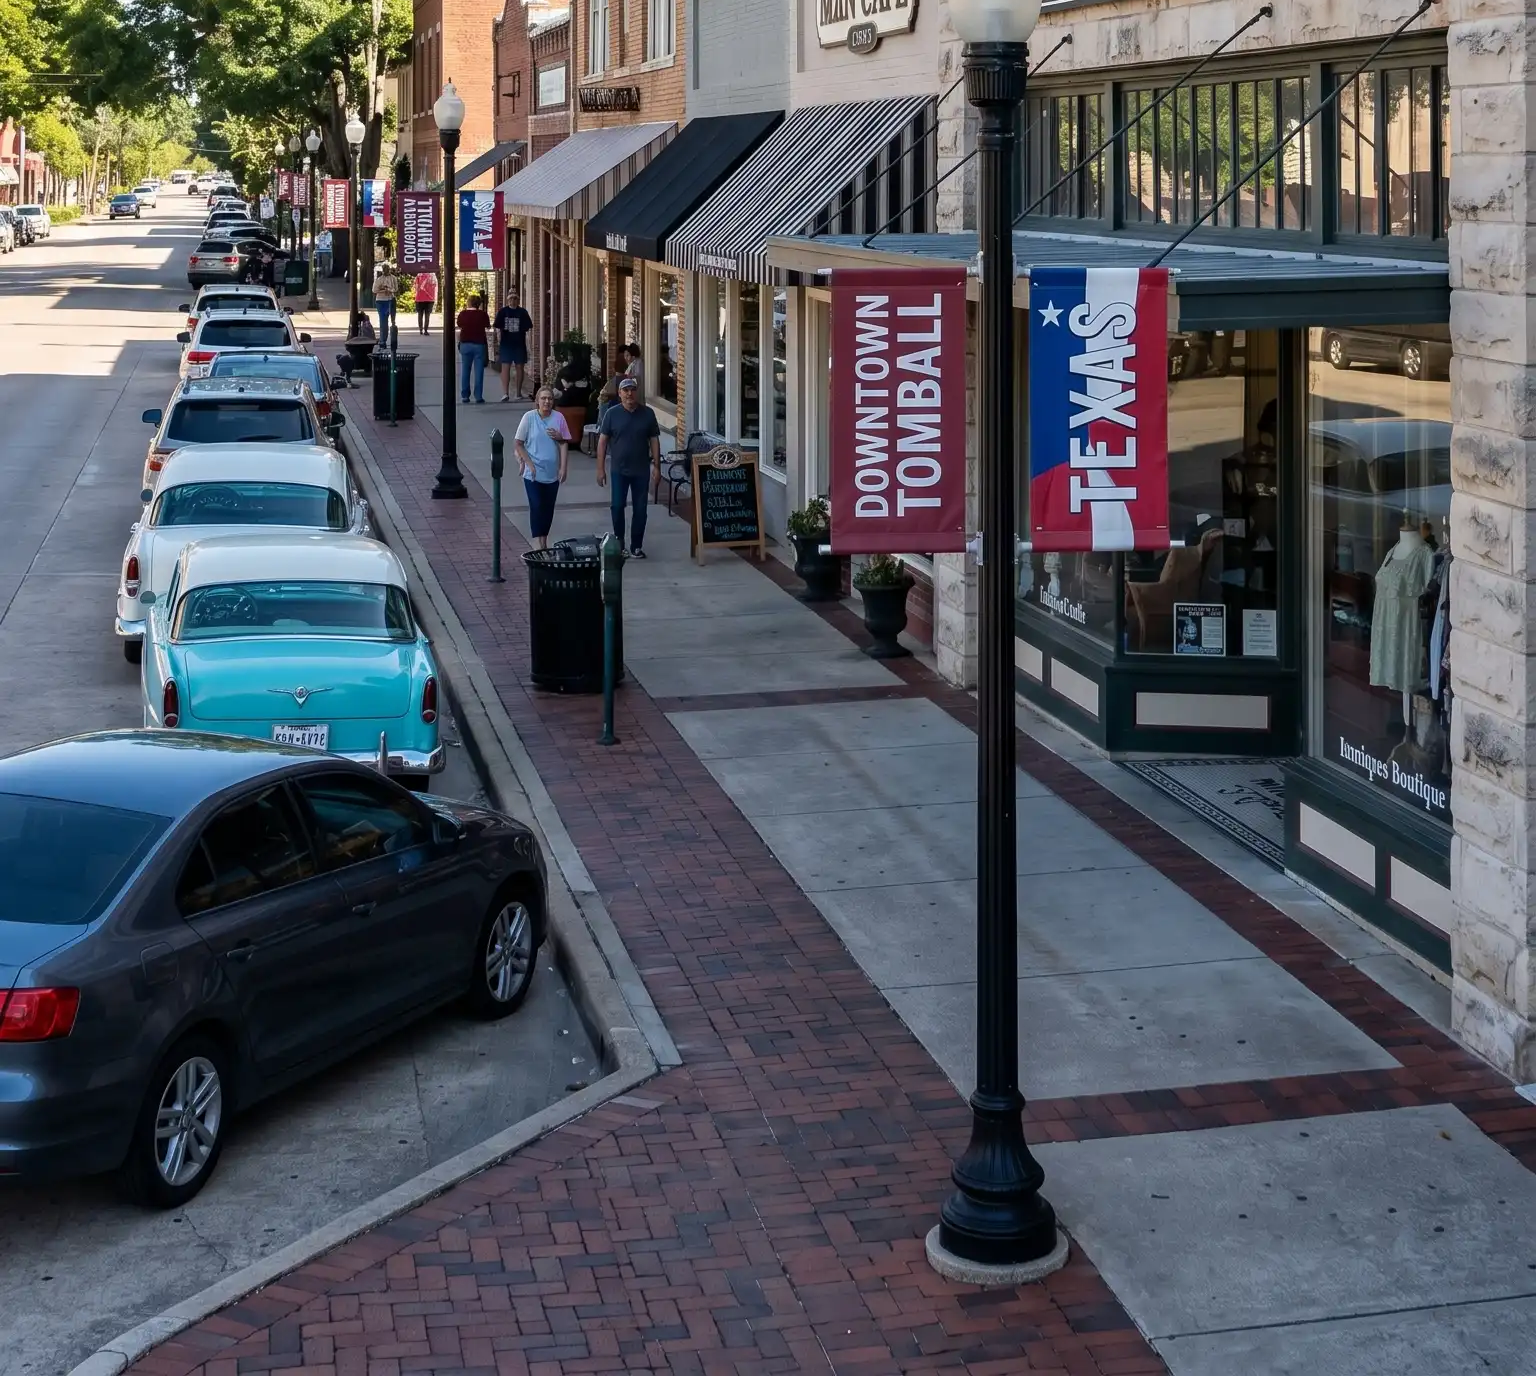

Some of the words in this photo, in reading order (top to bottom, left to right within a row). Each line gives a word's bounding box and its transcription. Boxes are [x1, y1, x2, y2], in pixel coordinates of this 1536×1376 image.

[854, 295, 890, 518] DOWNTOWN
[895, 293, 942, 517] TOMBALL
[1068, 301, 1138, 514] TEXAS
[1392, 760, 1446, 811] Boutique
